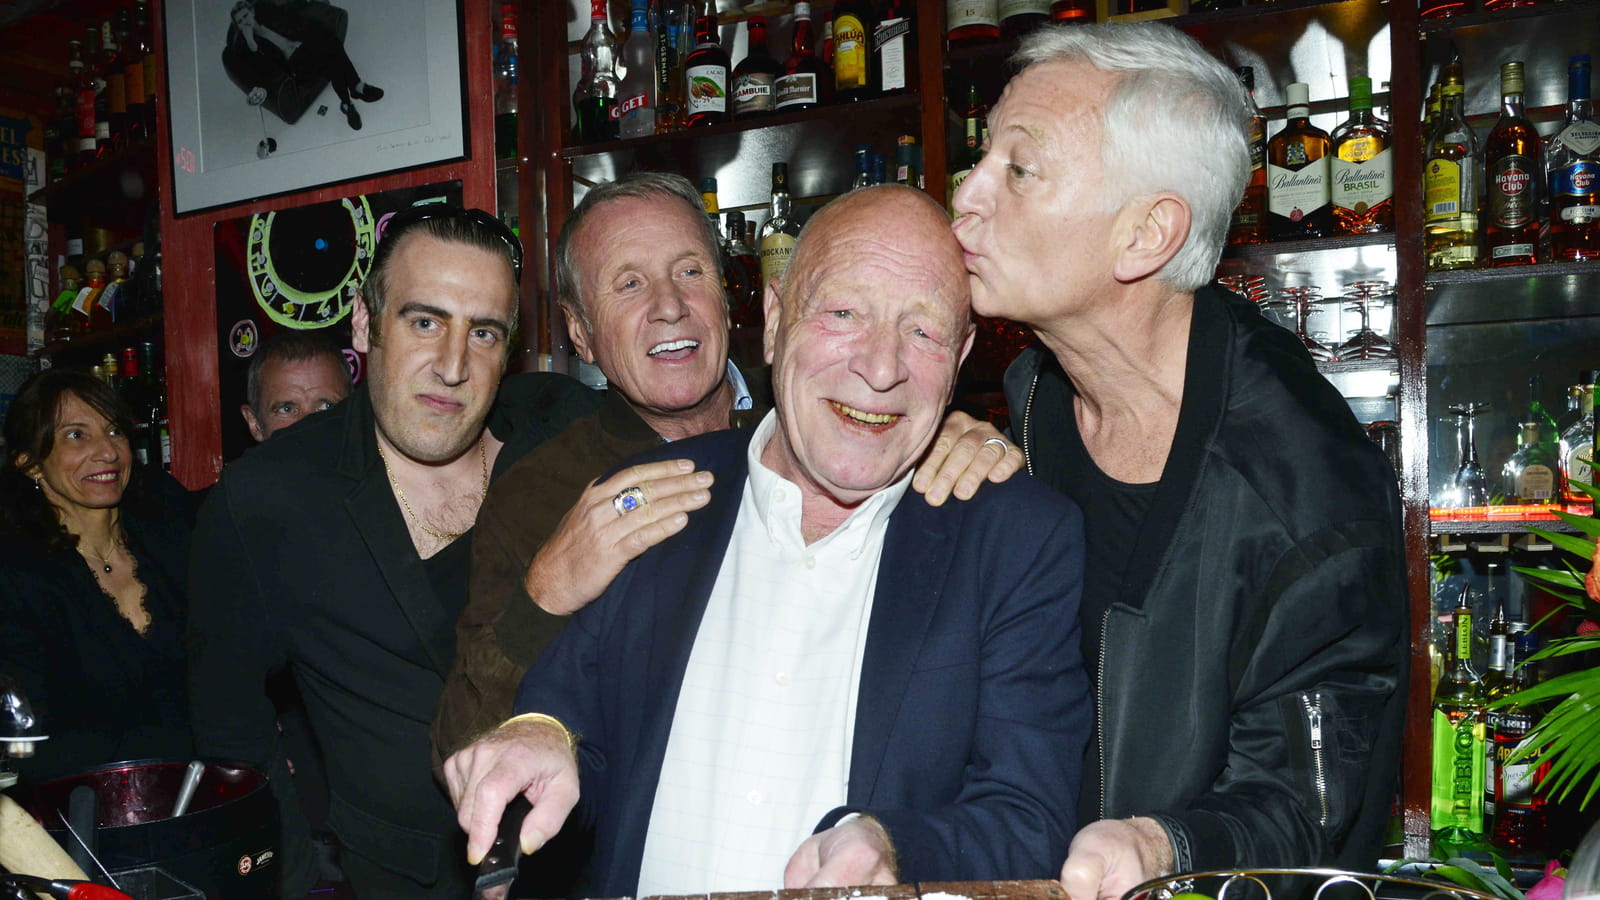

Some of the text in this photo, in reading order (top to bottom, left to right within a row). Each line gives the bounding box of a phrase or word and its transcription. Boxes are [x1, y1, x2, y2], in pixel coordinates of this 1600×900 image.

[621, 94, 646, 113] GET
[1272, 173, 1323, 190] Ballantine's
[1335, 168, 1385, 185] Ballantine's
[1495, 173, 1530, 184] Havana
[1570, 173, 1595, 181] Havana
[1575, 179, 1590, 187] Club
[1344, 180, 1380, 192] BRASIL
[1502, 181, 1523, 192] Club
[1460, 617, 1469, 656] LEBLON
[1455, 710, 1474, 815] LEBLON
